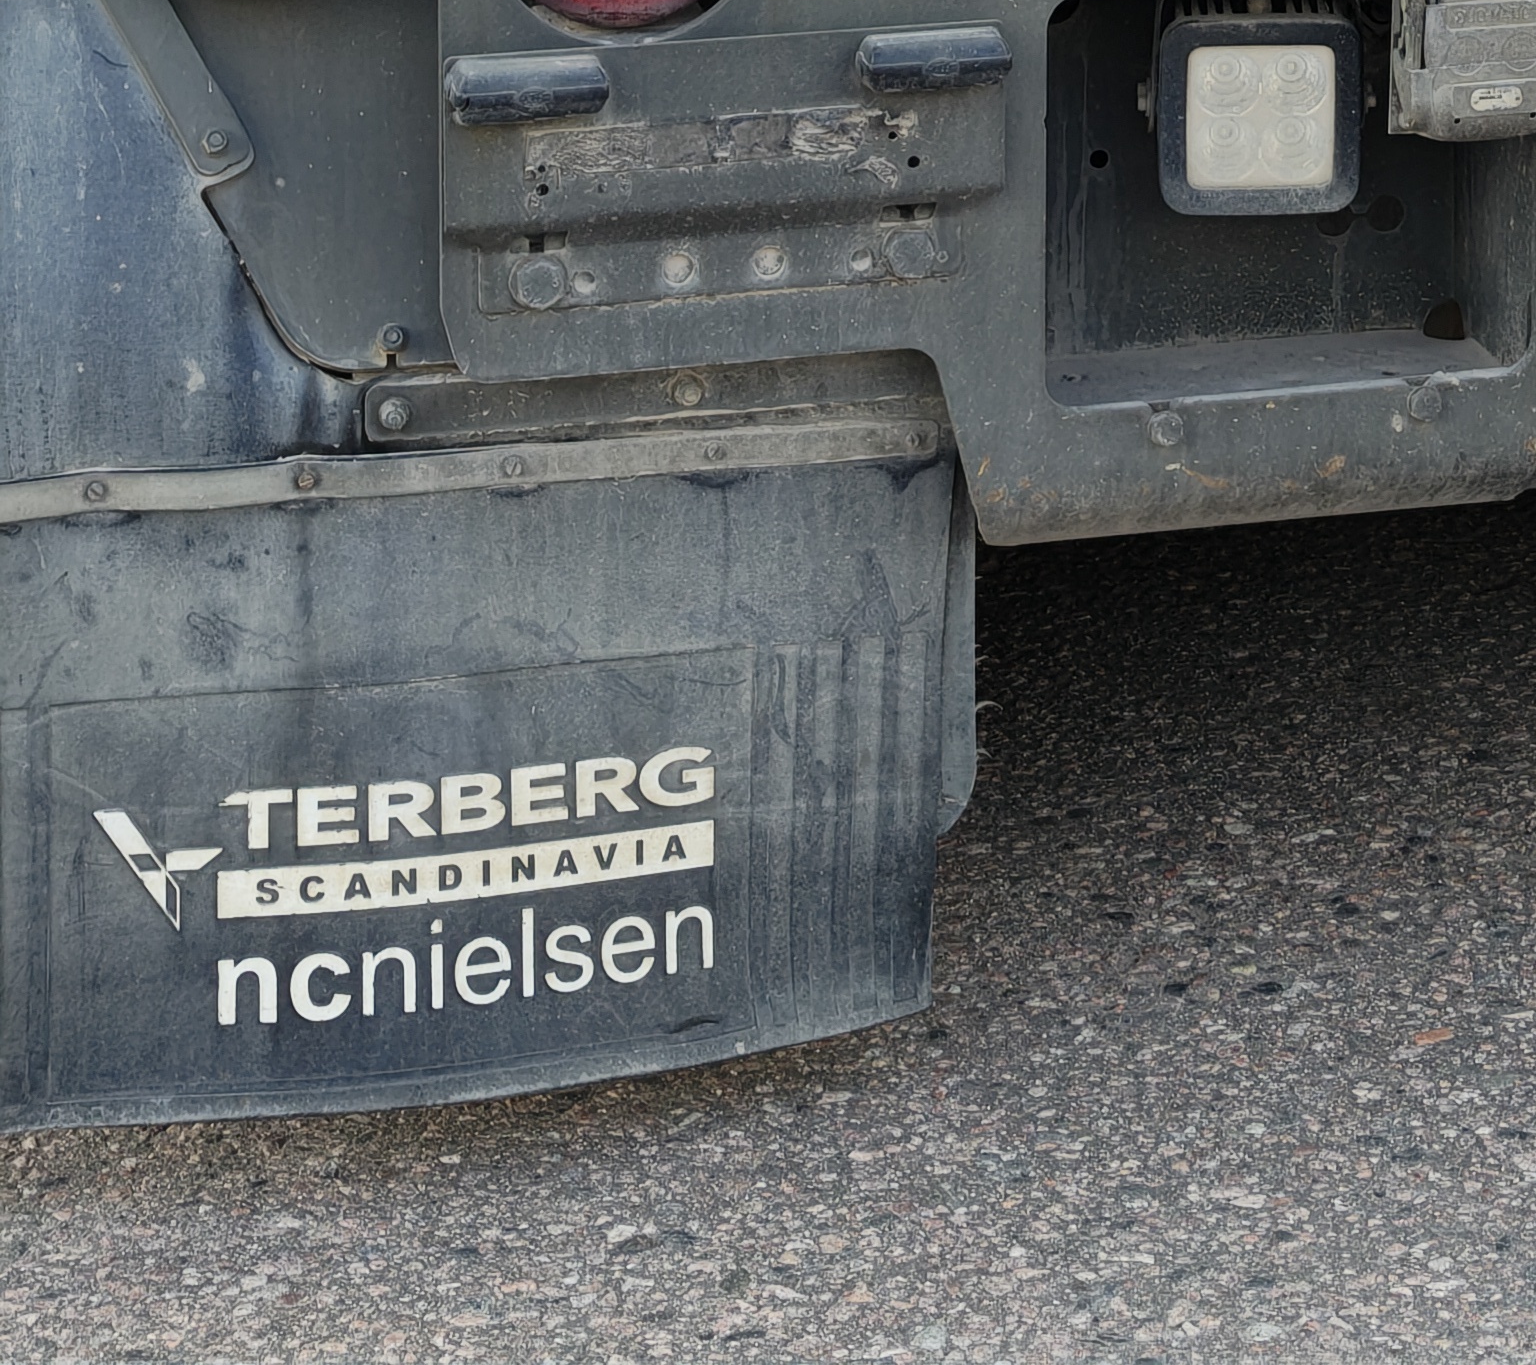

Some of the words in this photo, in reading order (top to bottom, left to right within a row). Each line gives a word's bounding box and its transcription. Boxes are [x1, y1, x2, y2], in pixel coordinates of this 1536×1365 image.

[219, 745, 715, 850] TERBERG
[255, 834, 688, 904] SCANDINAVIA
[217, 905, 715, 1026] ncnielsen
